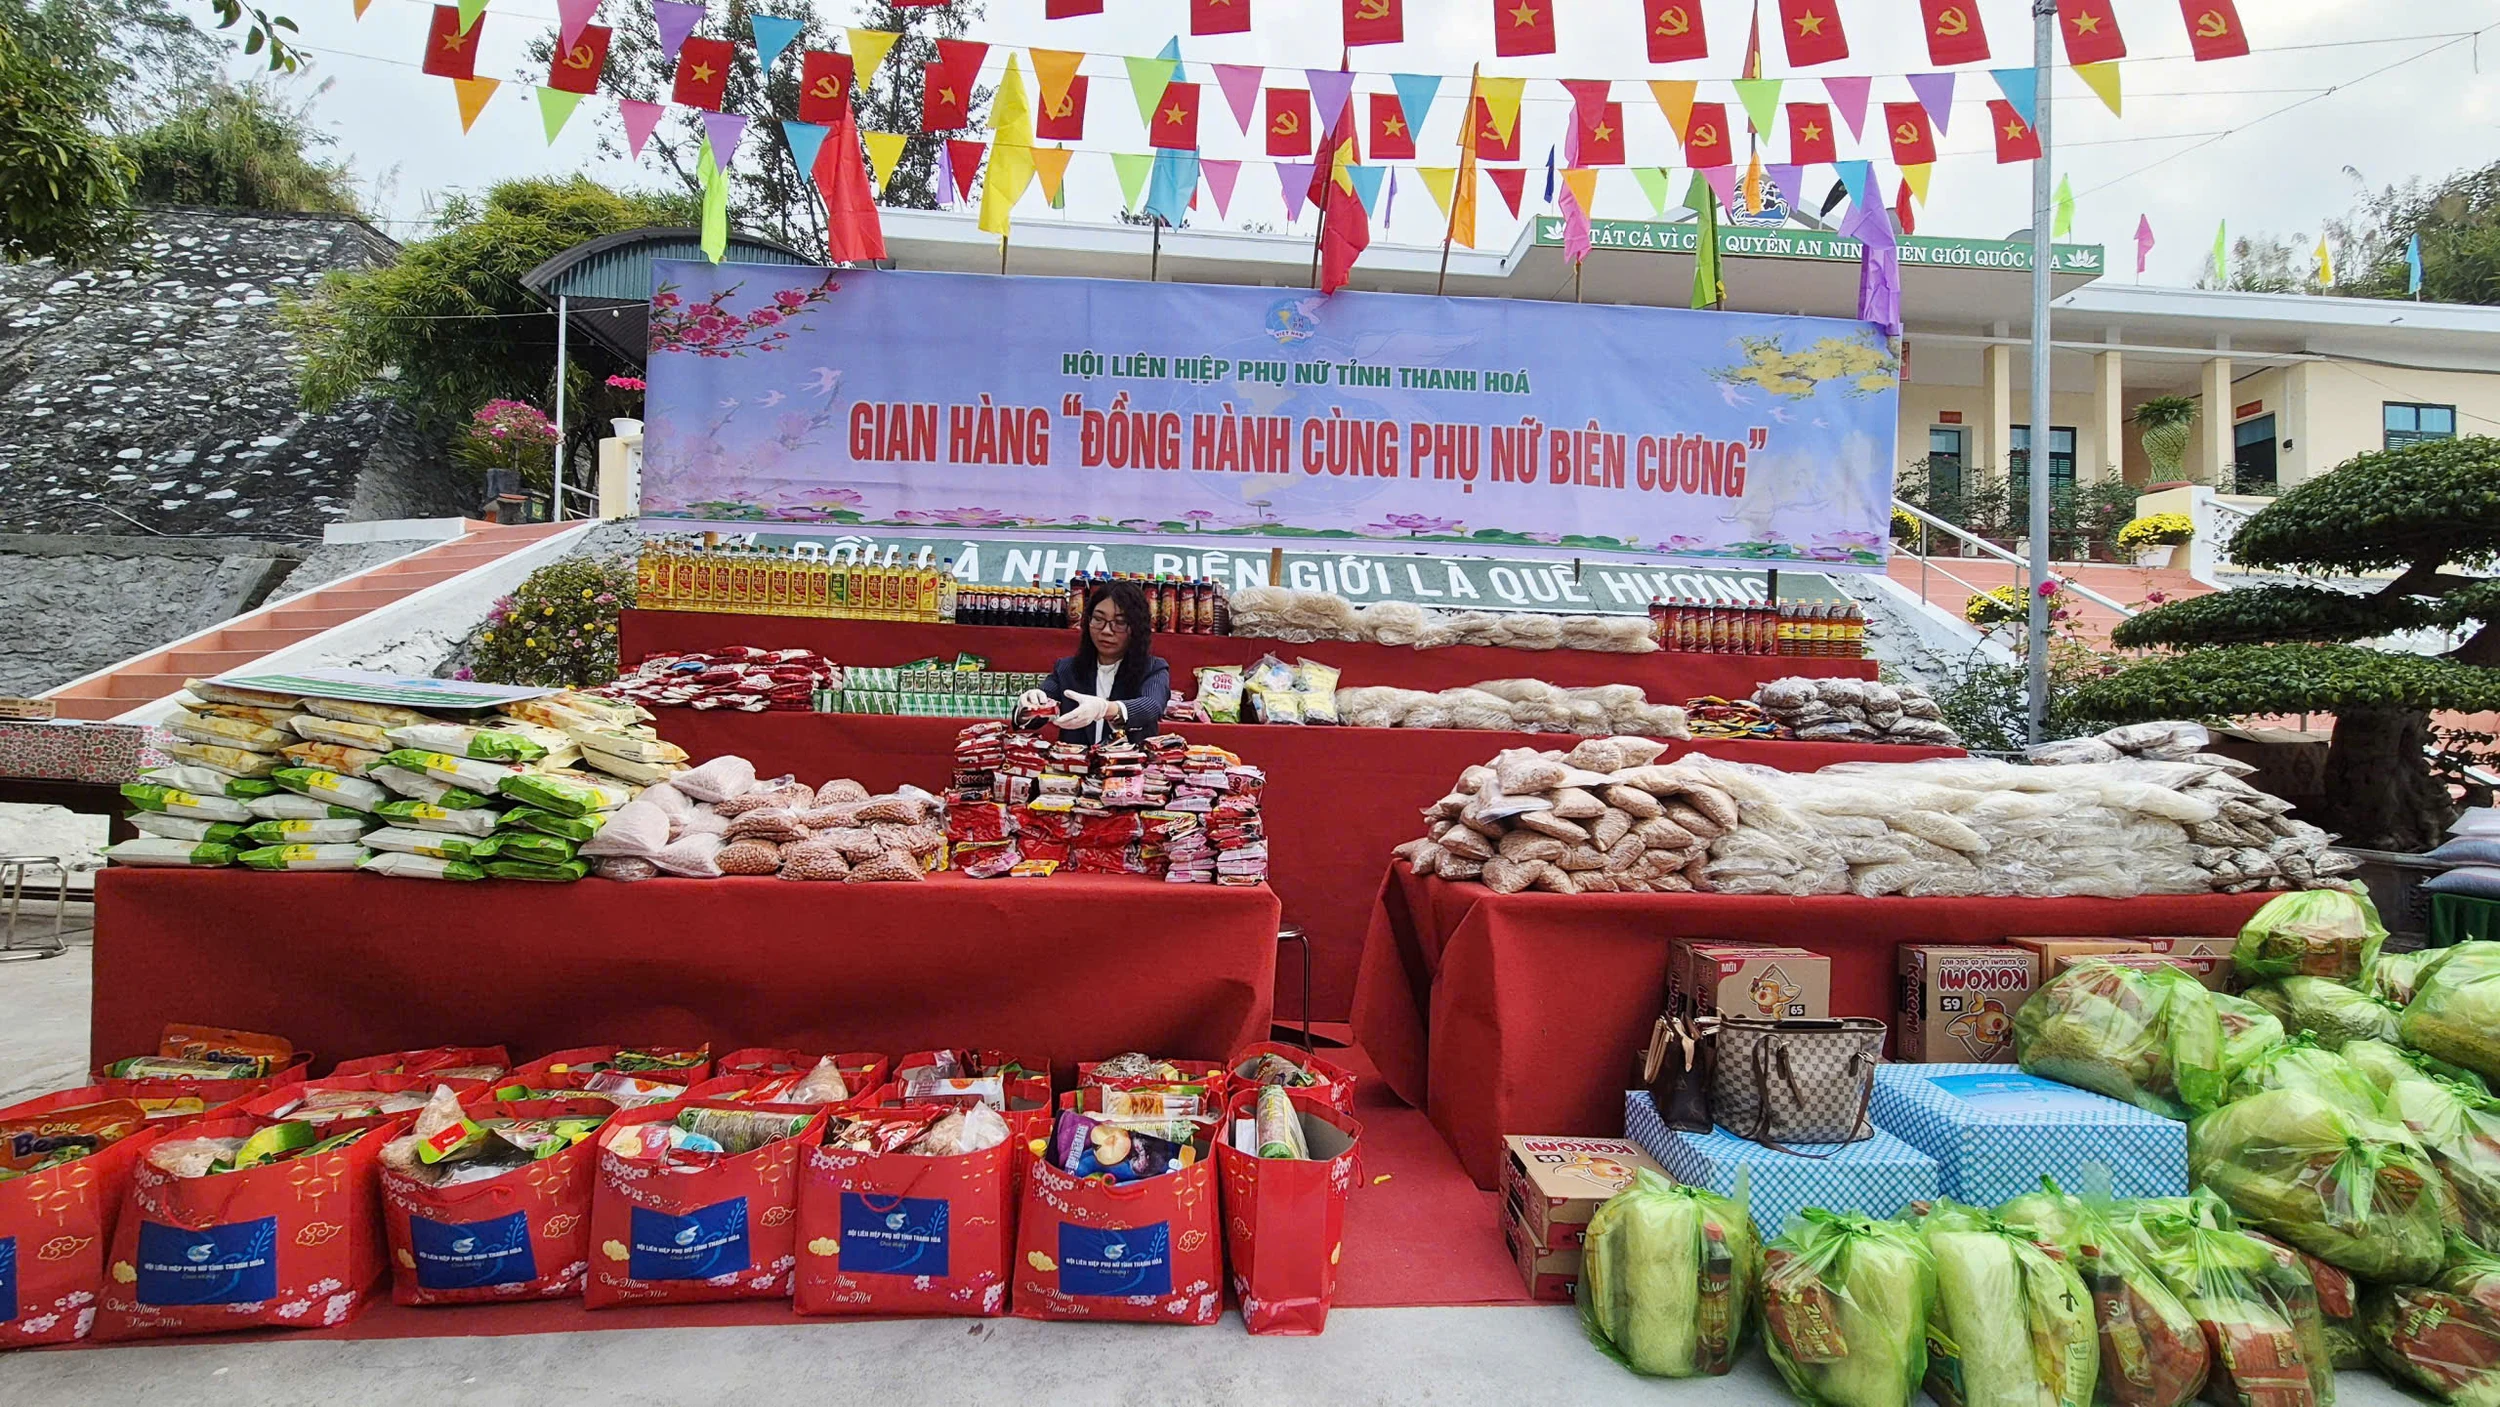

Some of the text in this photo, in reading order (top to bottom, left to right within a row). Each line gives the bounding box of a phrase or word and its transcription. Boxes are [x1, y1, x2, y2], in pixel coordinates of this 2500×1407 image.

[1589, 222, 1625, 245] TẤT
[1628, 225, 1653, 247] CẢ
[1658, 228, 1678, 248] VÌ
[1726, 230, 1791, 254] QUYỀN
[1795, 240, 1823, 255] AN
[1828, 241, 1863, 259] NIN
[1897, 241, 1927, 262] IÊN
[1932, 243, 1971, 264] GIỚI
[1975, 244, 2024, 267] QUỐC
[1063, 352, 1530, 394] HỘI LIÊN HIỆP PHỤ NỮ TỈNH THANH HOÁ
[850, 402, 936, 462] GIAN
[949, 394, 1049, 465] HÀNG
[1193, 403, 1290, 473] HÀNH
[1302, 407, 1398, 477] CÙNG
[1410, 422, 1479, 493] PHỤ
[1490, 417, 1543, 484] NỮ
[1550, 420, 1625, 489] BIÊN
[1153, 551, 1271, 590] BIÊN
[1289, 556, 1391, 595] GIỚI
[1406, 560, 1480, 599] LÀ
[1488, 564, 1590, 604] QUÊ
[1599, 571, 1780, 606] HƯƠNG
[1907, 963, 1920, 1033] KOKOMI
[1939, 969, 2028, 990] KOKOMI
[1790, 1009, 1803, 1018] 65
[1943, 998, 1960, 1010] 65
[40, 1122, 81, 1136] Cake
